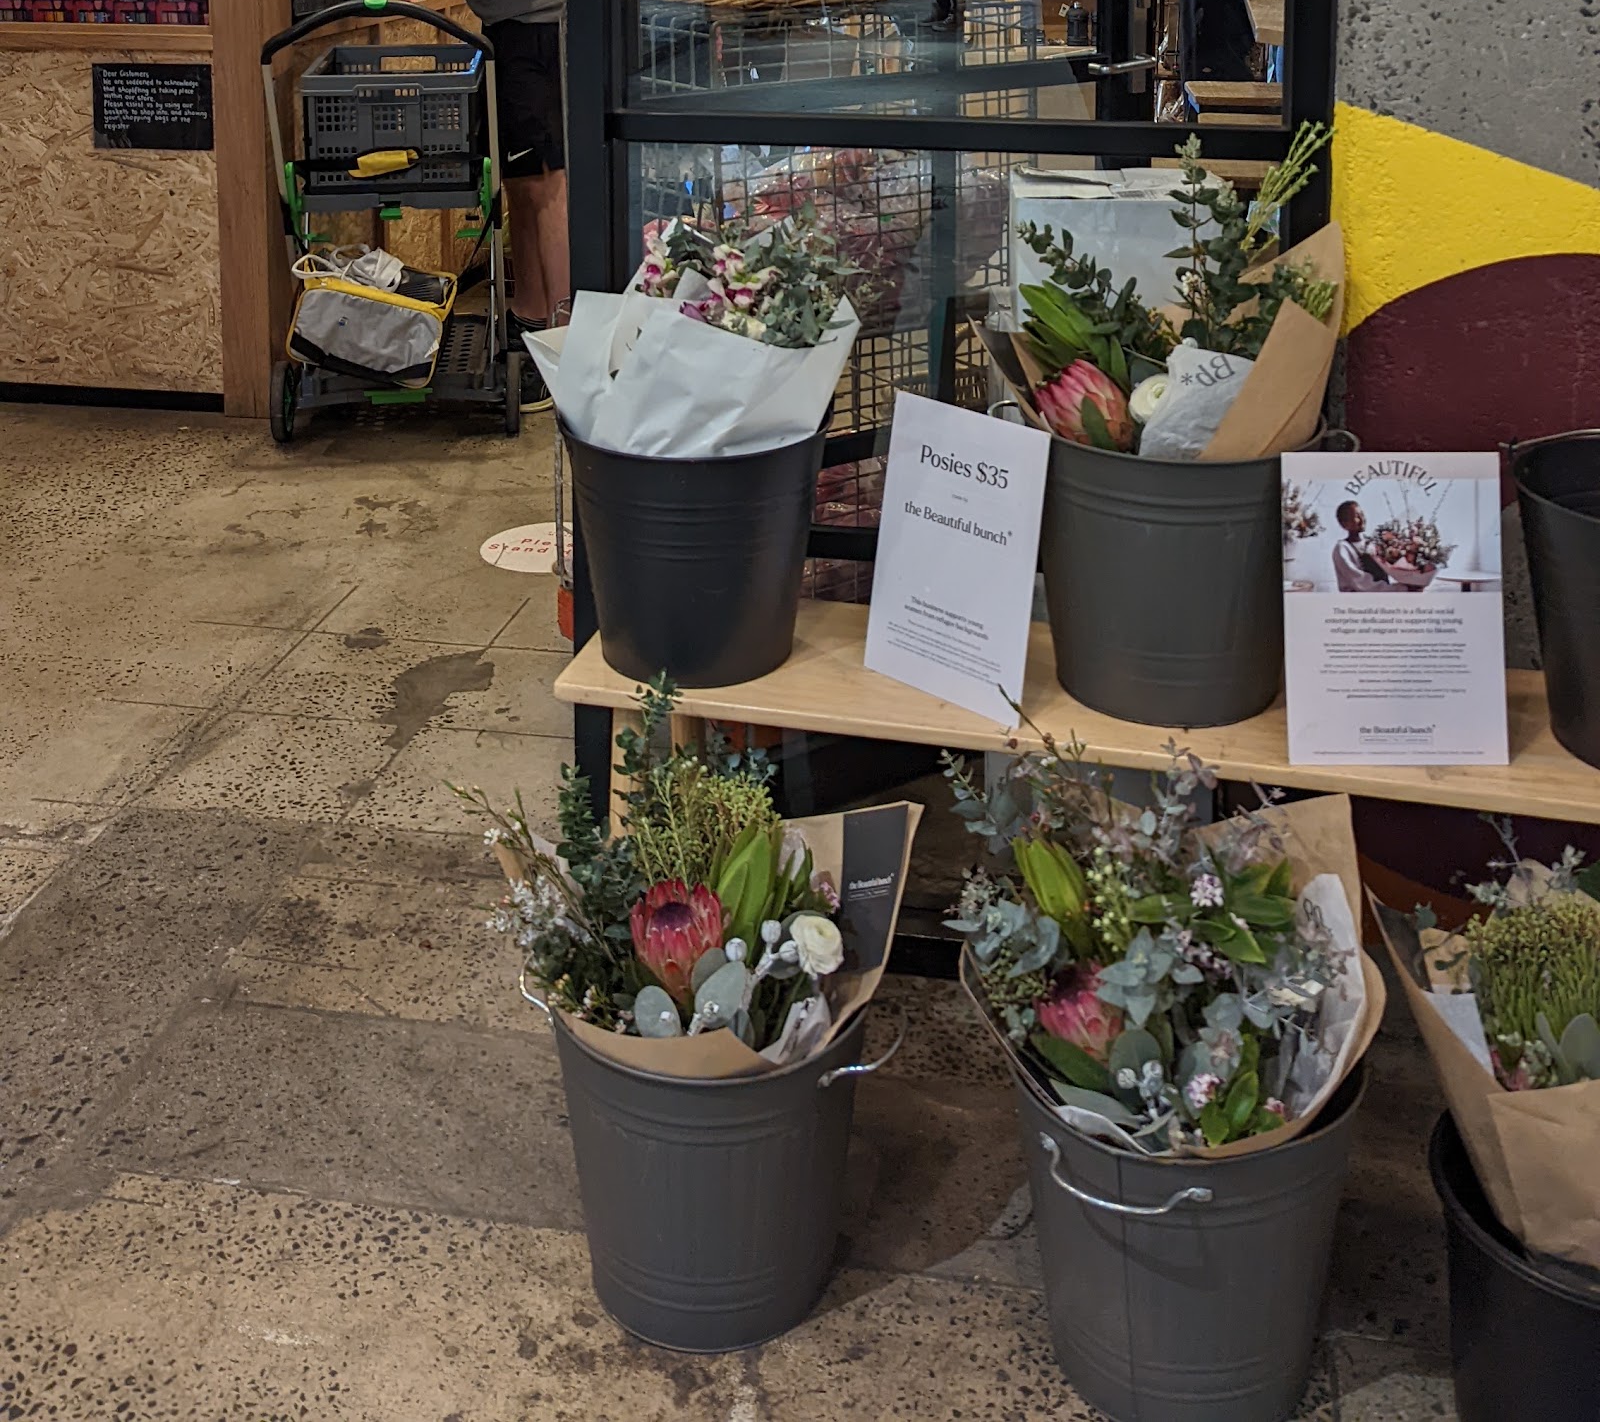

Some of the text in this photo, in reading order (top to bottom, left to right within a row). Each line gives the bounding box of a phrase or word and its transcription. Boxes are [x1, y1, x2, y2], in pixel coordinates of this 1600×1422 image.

[920, 444, 1009, 489] Posies $35
[1344, 460, 1440, 497] BEAUTIFUL
[904, 500, 922, 517] the
[923, 506, 972, 534] Beautiful
[488, 543, 549, 554] Stand
[521, 538, 573, 548] Ples
